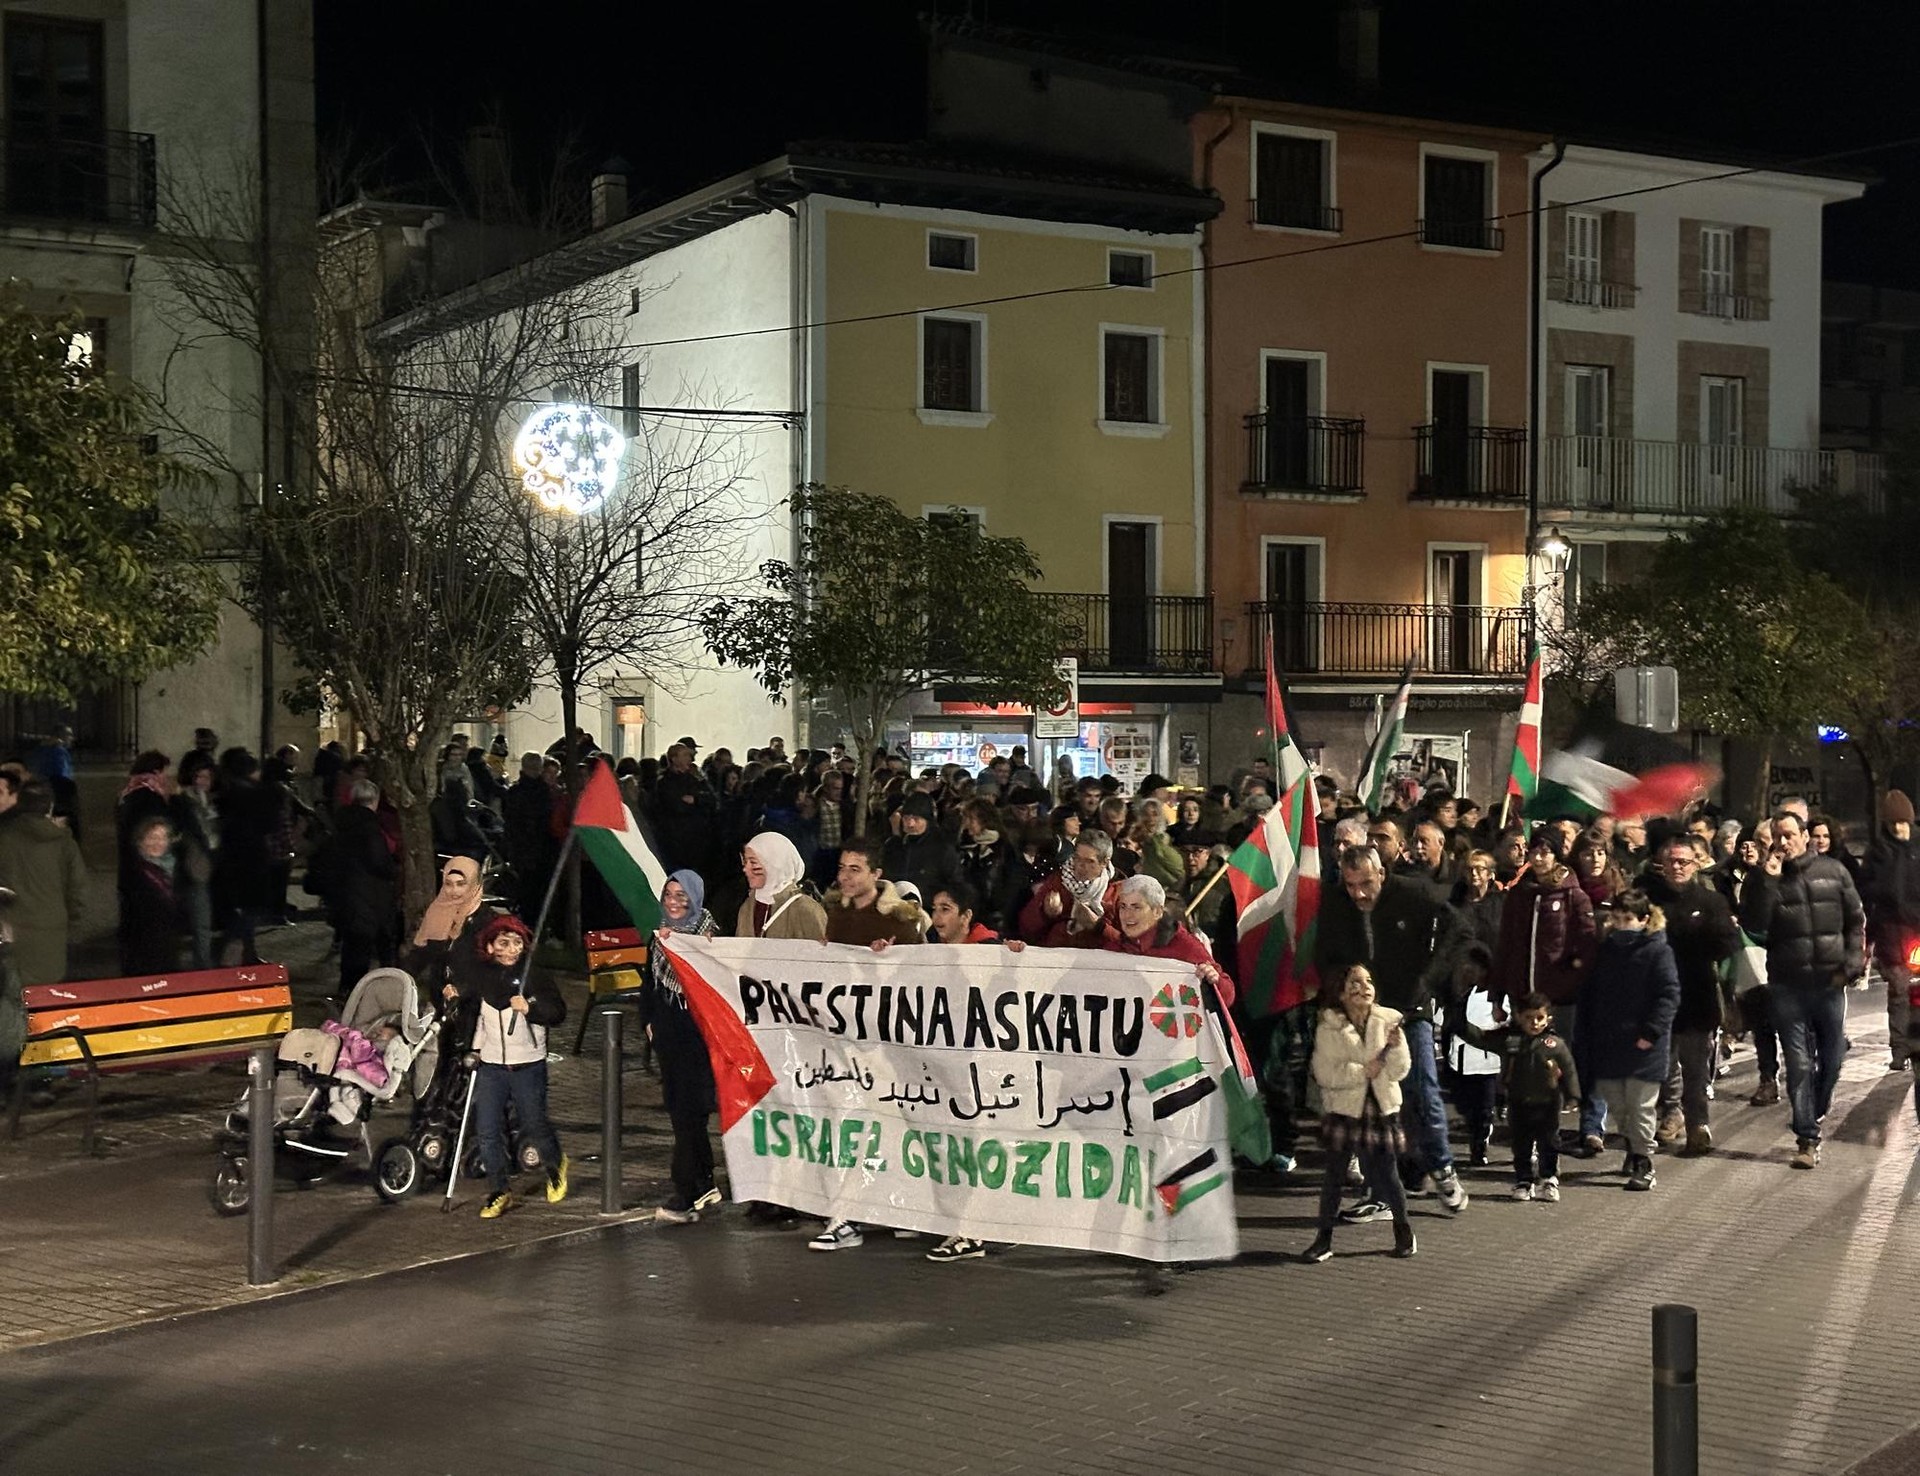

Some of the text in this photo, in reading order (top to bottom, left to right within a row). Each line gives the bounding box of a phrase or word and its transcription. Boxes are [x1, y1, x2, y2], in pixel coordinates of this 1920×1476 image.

[739, 975, 1144, 1057] PALESTINA ASKATU
[752, 1108, 887, 1172] ISRAEL
